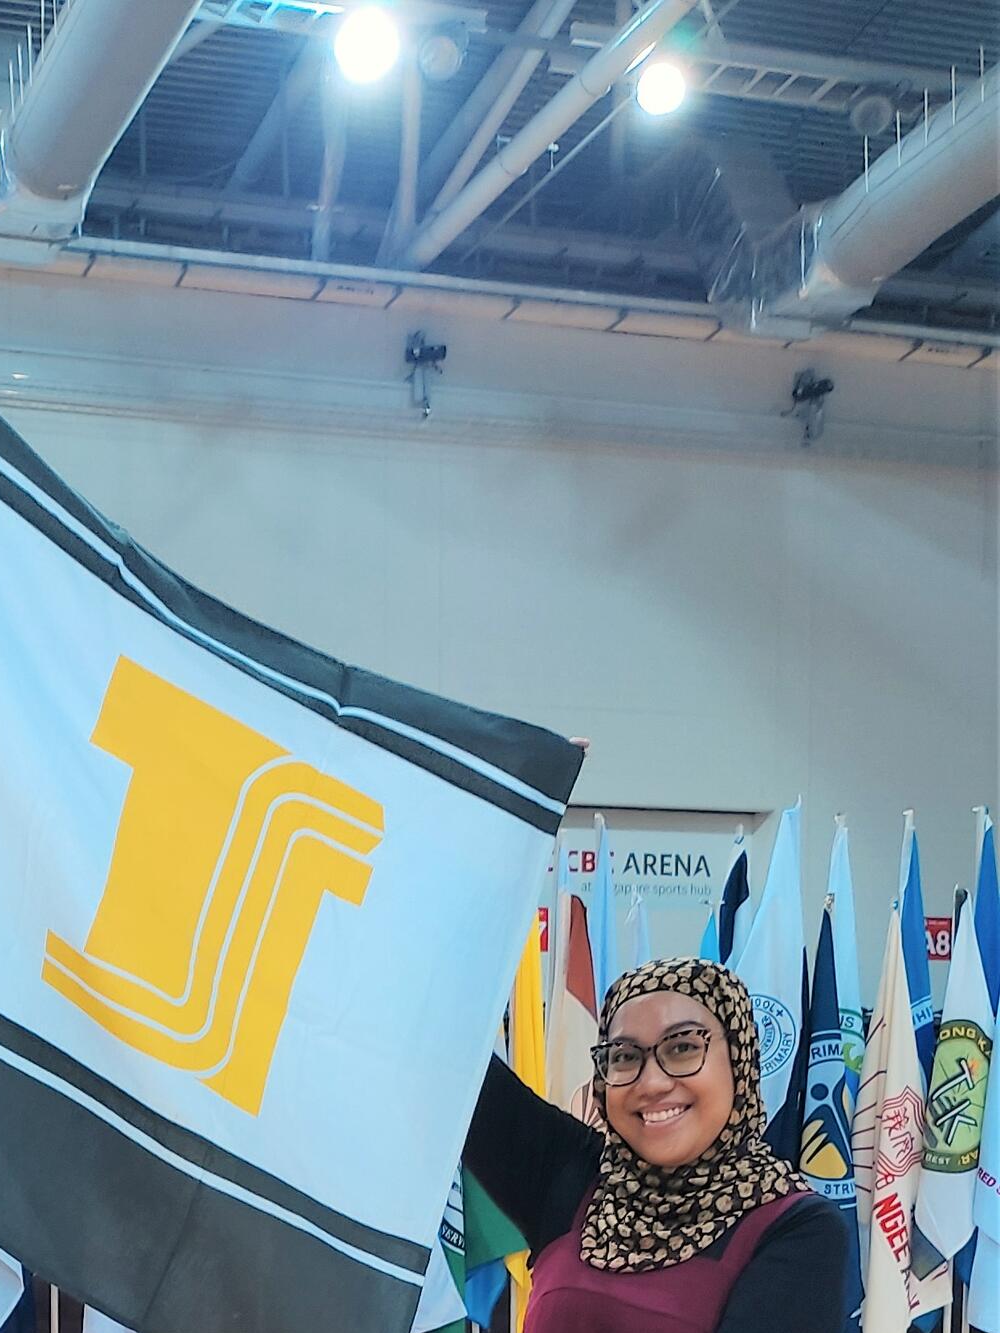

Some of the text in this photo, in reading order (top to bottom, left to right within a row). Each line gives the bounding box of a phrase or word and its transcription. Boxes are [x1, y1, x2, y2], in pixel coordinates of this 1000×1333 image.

[622, 852, 711, 878] ARENA
[653, 882, 687, 896] sports
[690, 882, 712, 896] hub
[874, 1192, 910, 1263] NGEE
